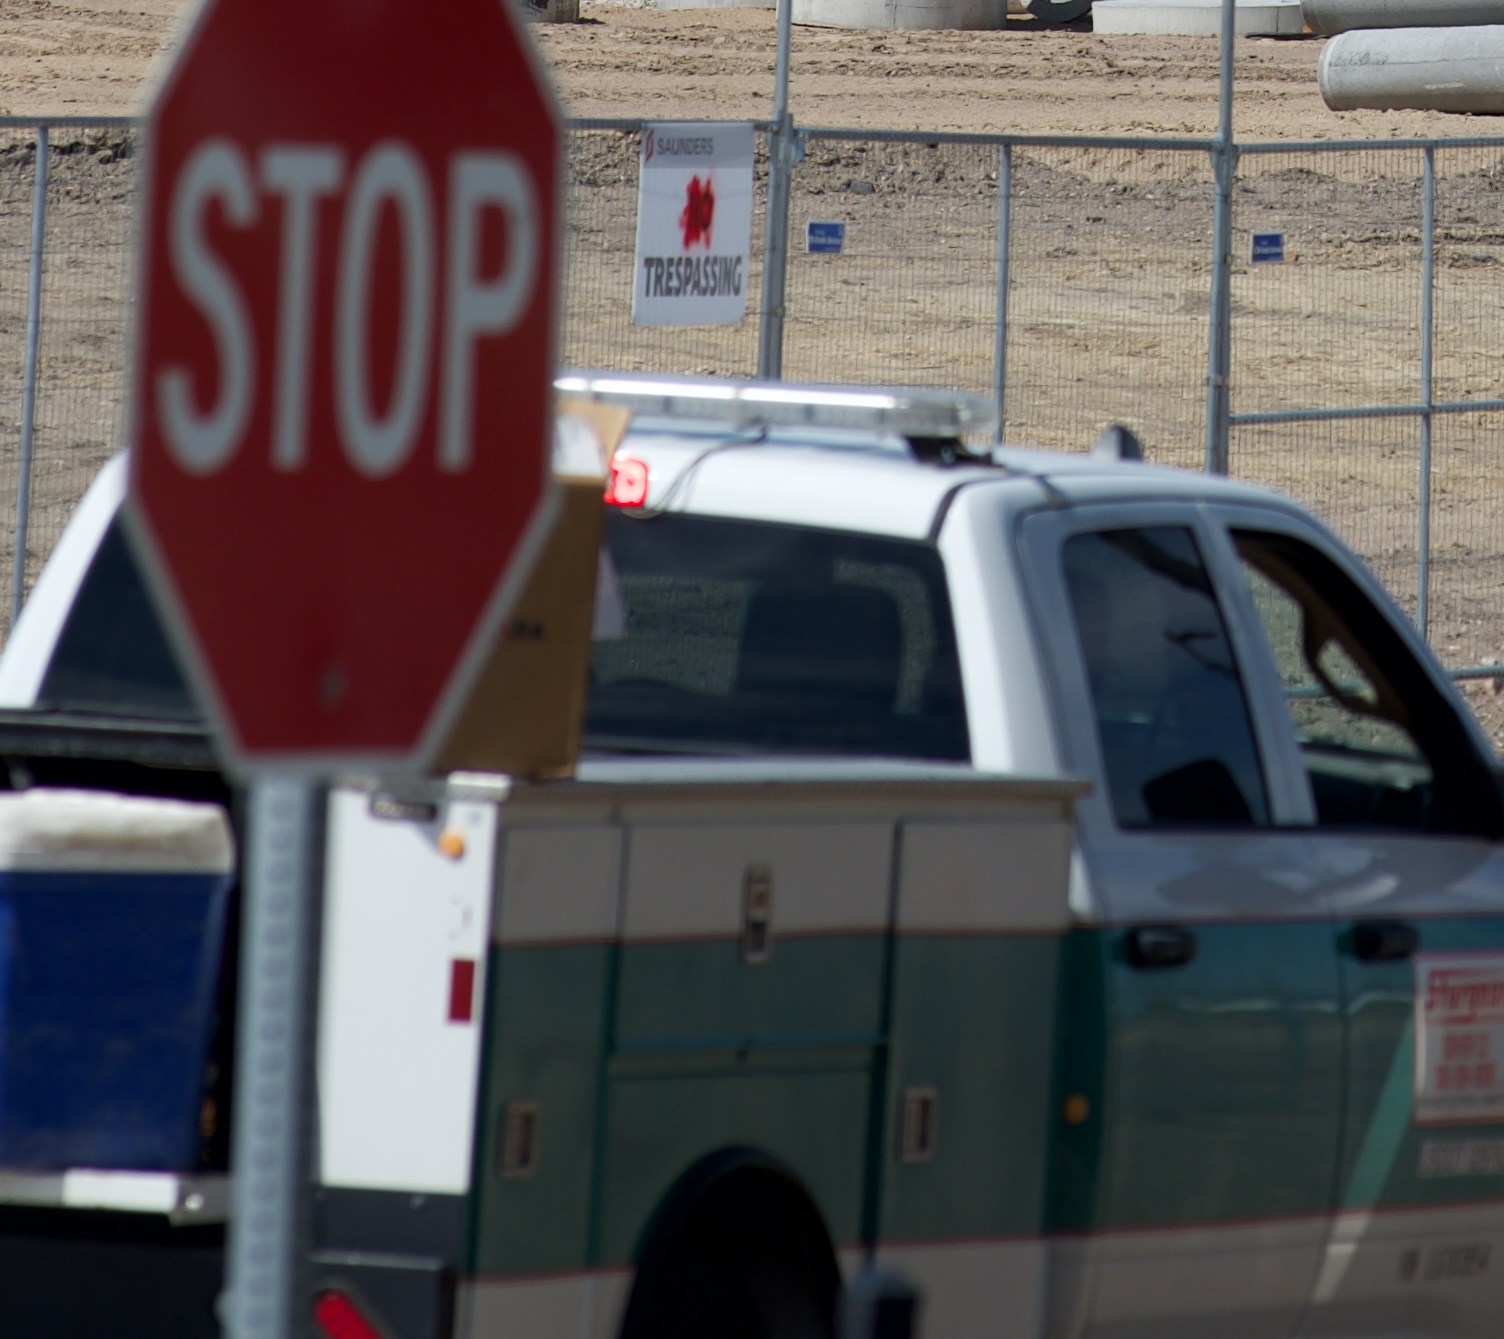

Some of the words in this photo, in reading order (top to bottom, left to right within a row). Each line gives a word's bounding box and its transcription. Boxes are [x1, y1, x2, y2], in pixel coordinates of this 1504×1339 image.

[656, 137, 714, 157] SAUNDERS
[643, 255, 743, 298] TRESPASSING
[156, 138, 541, 478] STOP
